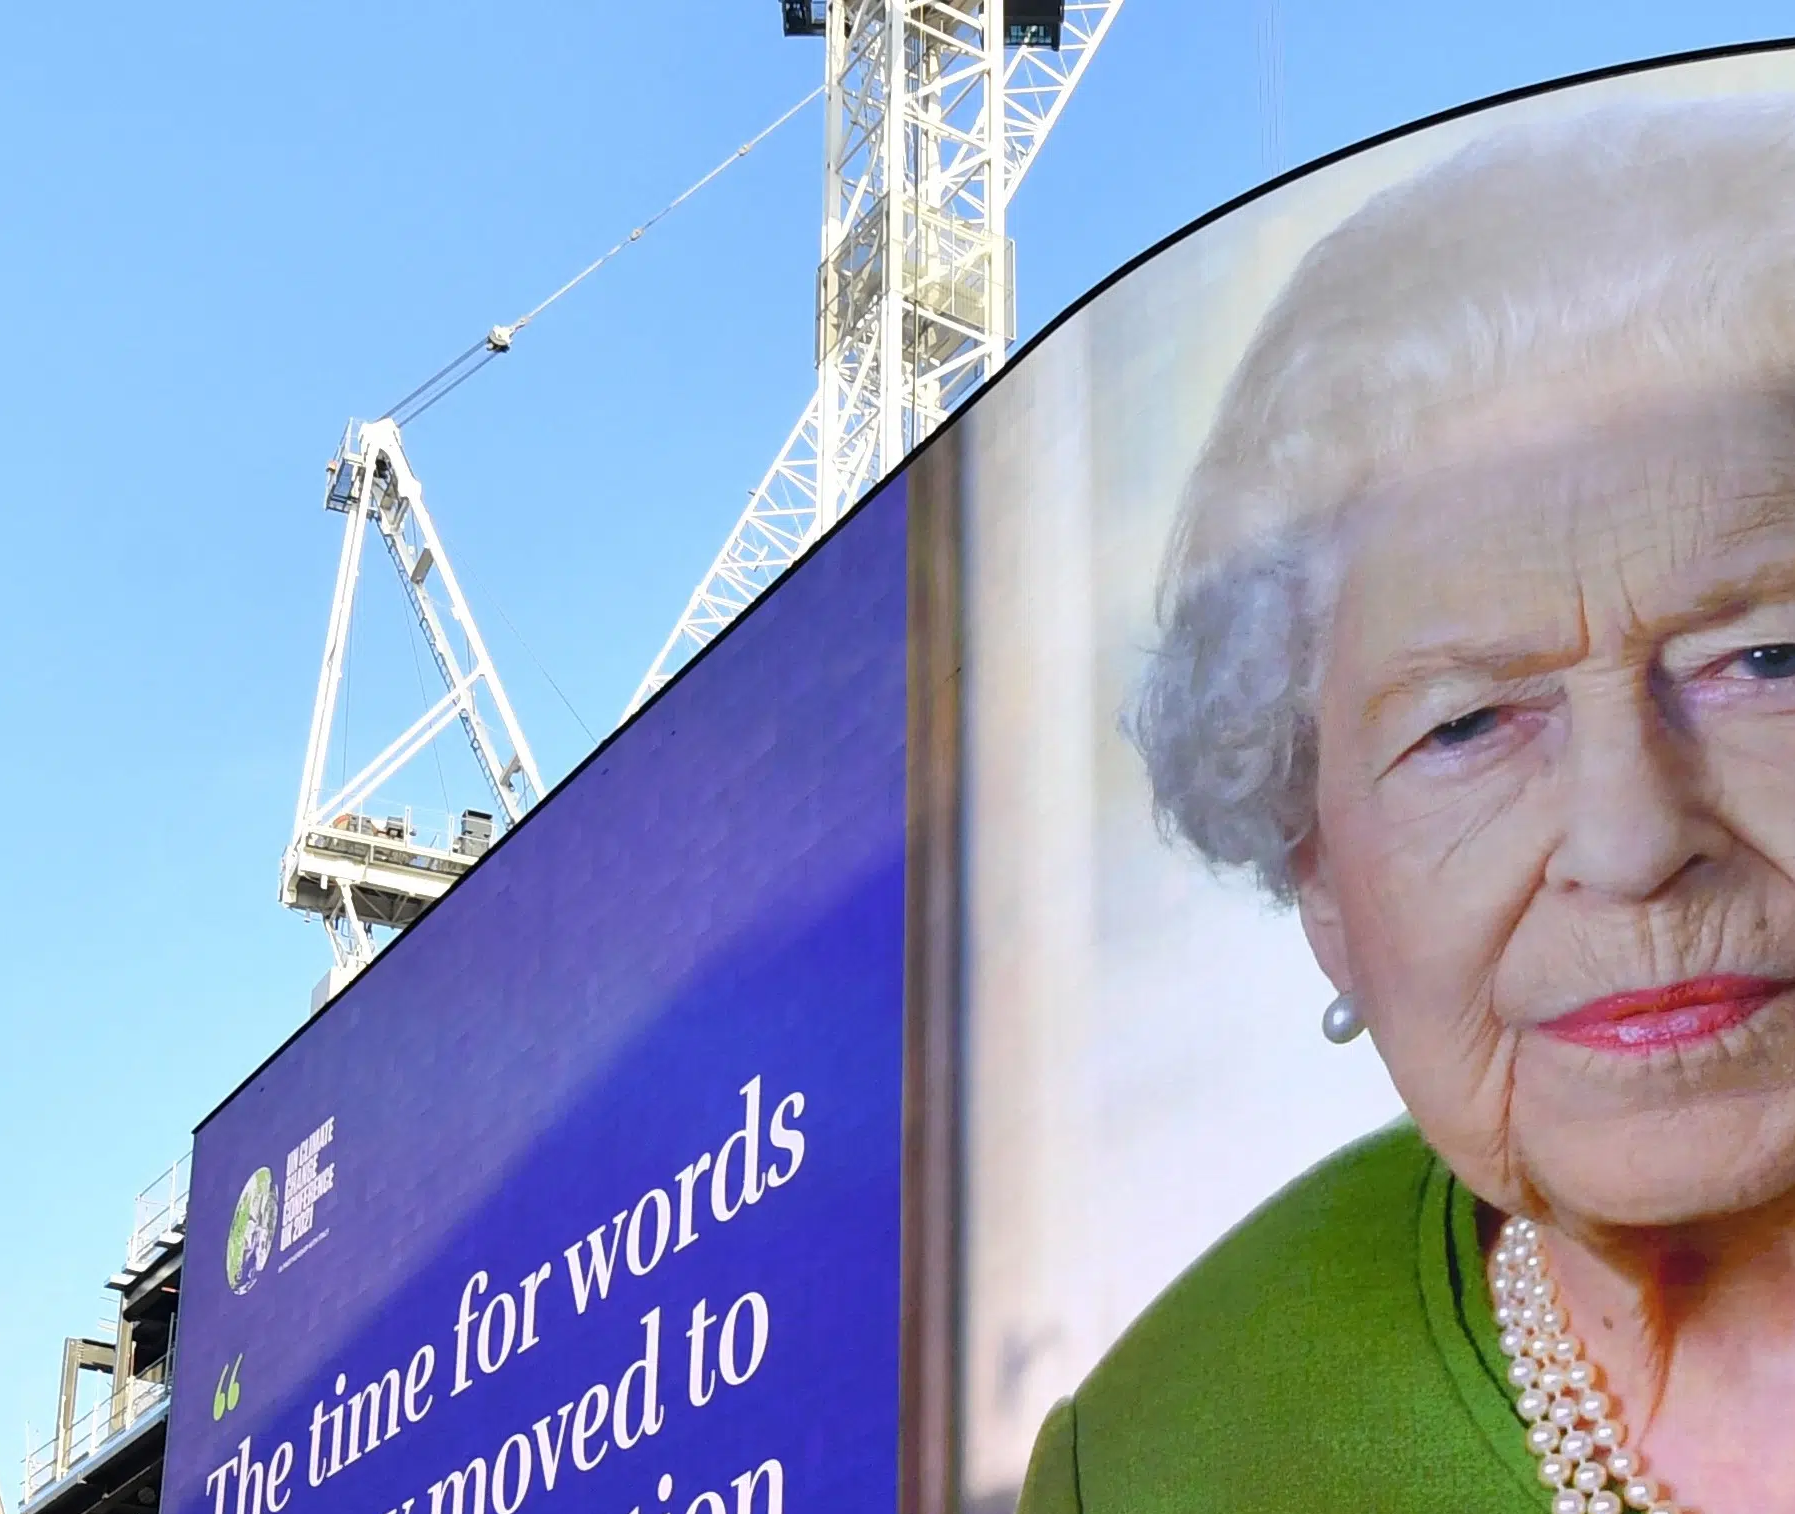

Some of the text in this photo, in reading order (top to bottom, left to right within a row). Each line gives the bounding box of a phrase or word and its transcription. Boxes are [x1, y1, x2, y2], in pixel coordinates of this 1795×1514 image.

[308, 1343, 435, 1488] time
[450, 1270, 552, 1397] for
[564, 1073, 805, 1316] words
[685, 1291, 769, 1409] to
